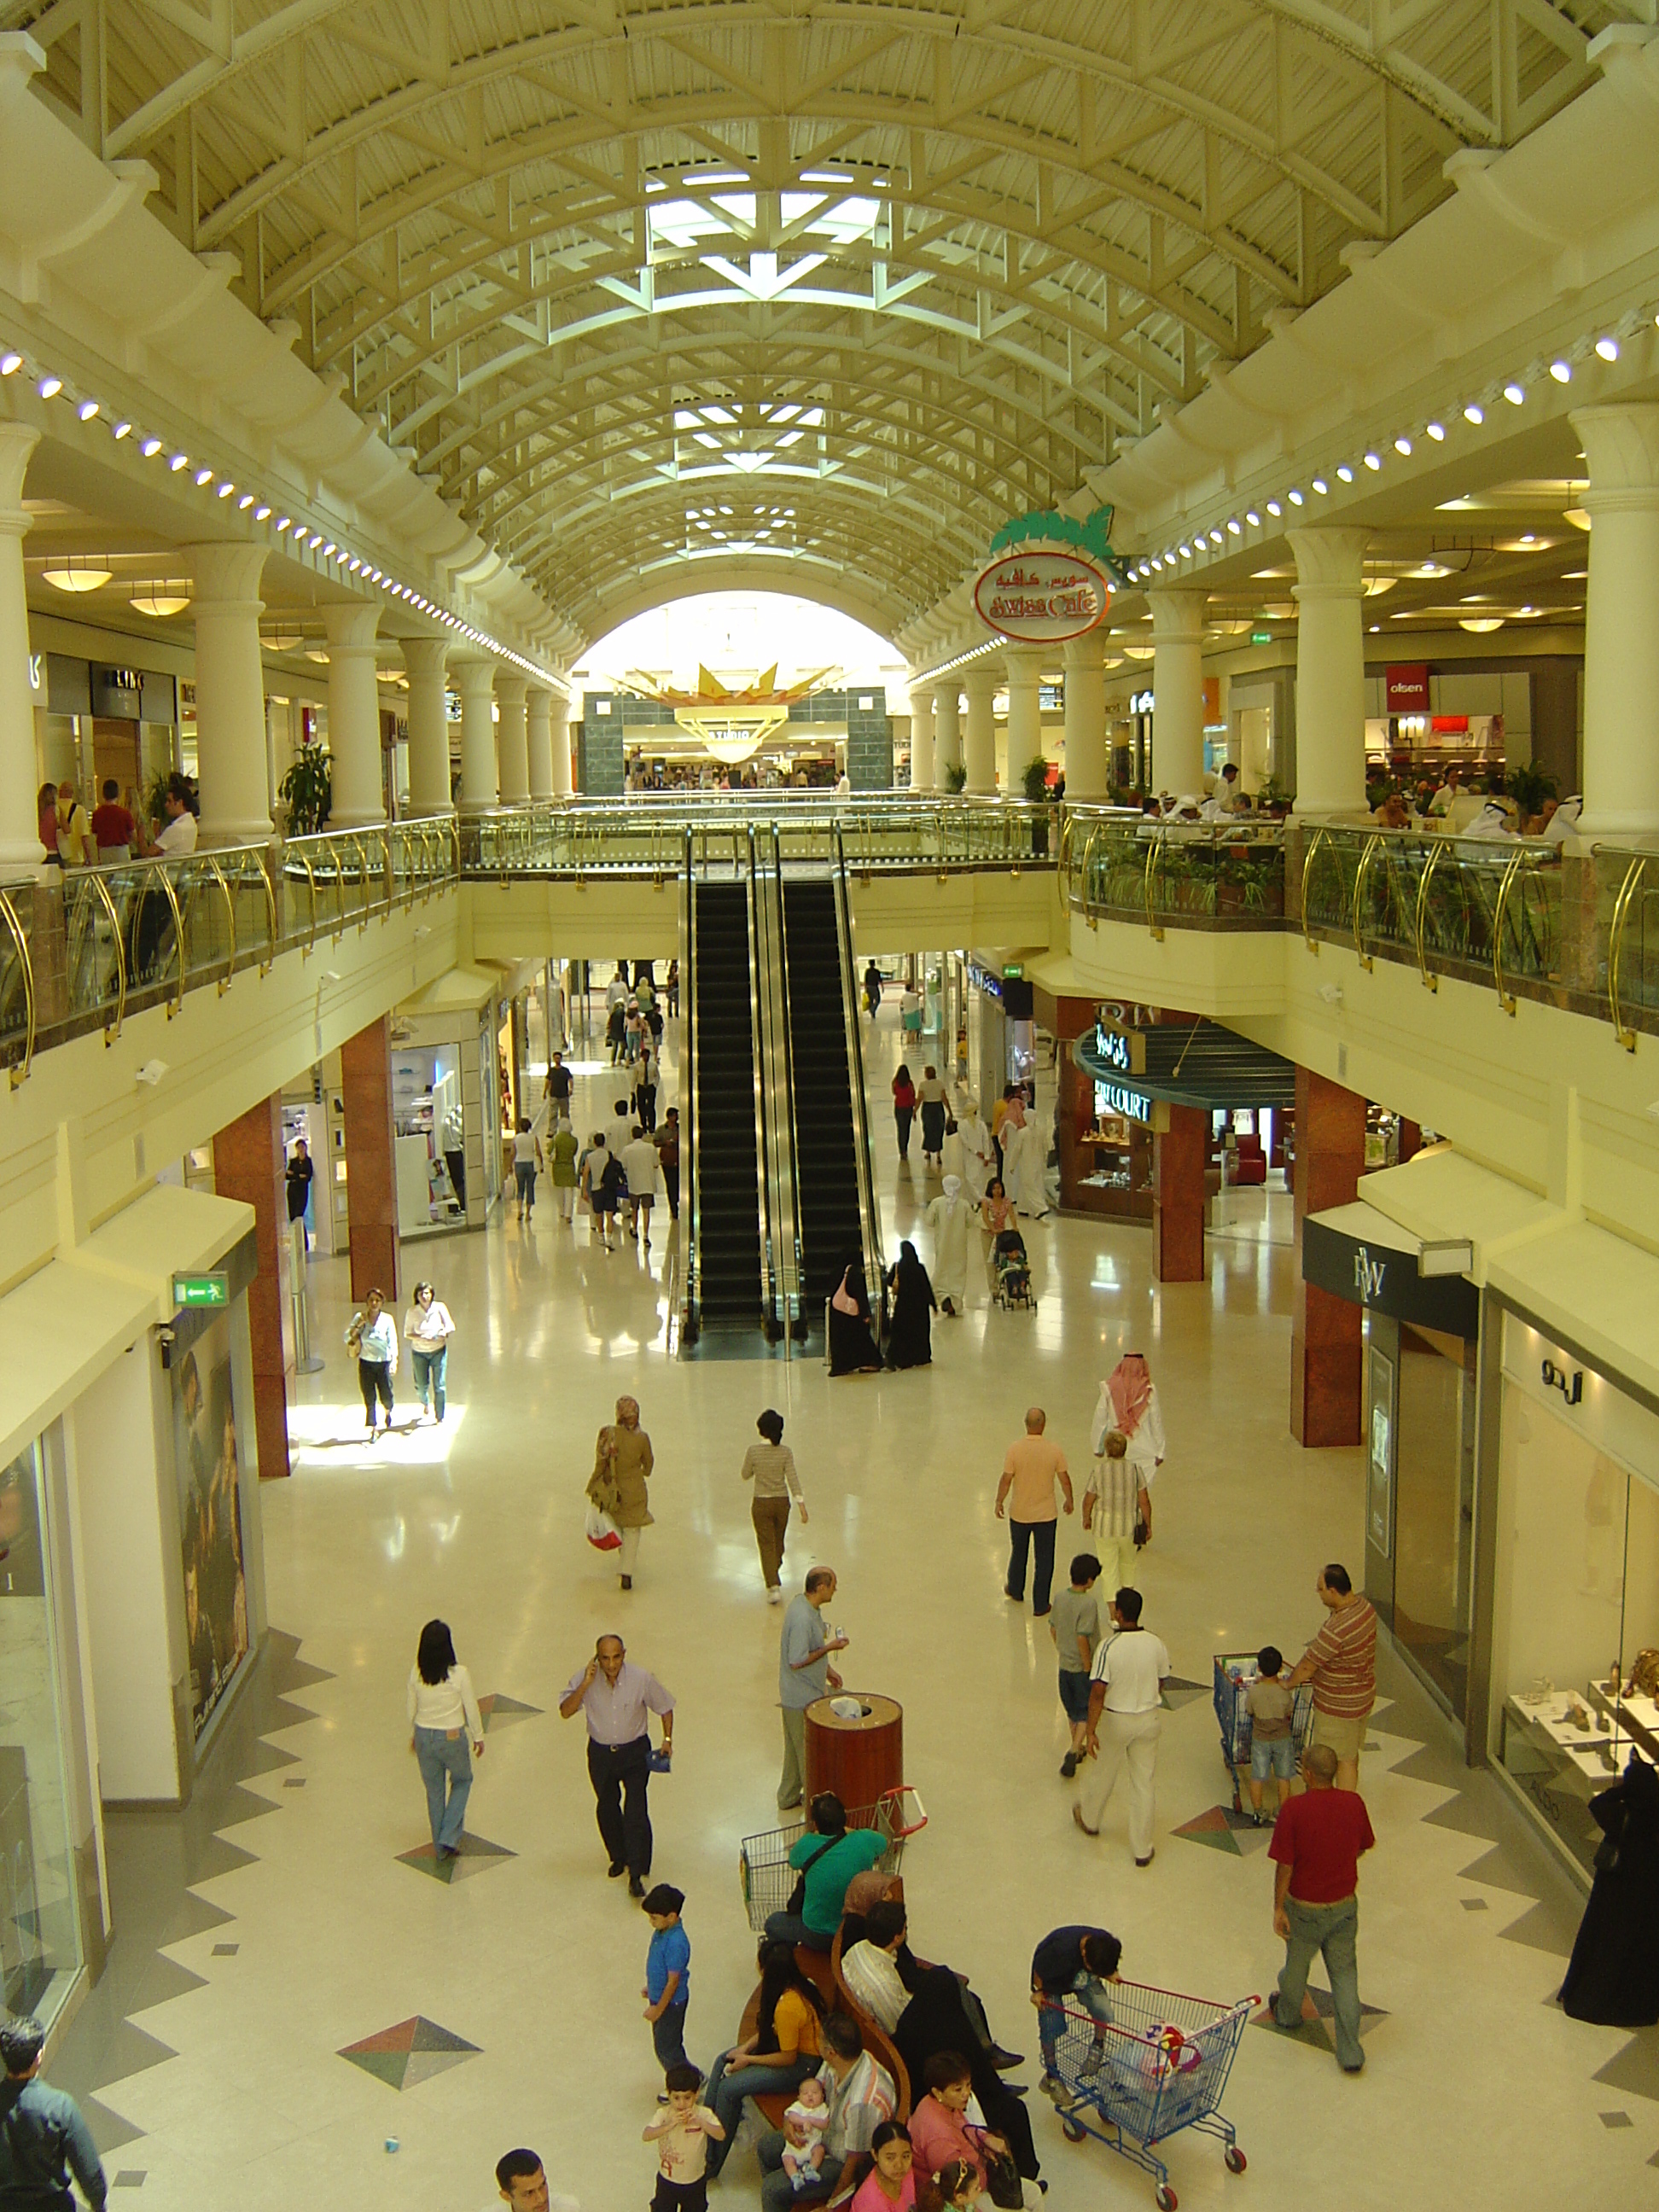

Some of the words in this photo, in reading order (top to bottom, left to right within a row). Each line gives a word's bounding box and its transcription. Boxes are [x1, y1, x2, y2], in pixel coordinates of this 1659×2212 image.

[989, 596, 1046, 619] Swiss
[1390, 683, 1423, 693] olsen
[1110, 1085, 1151, 1122] COURT
